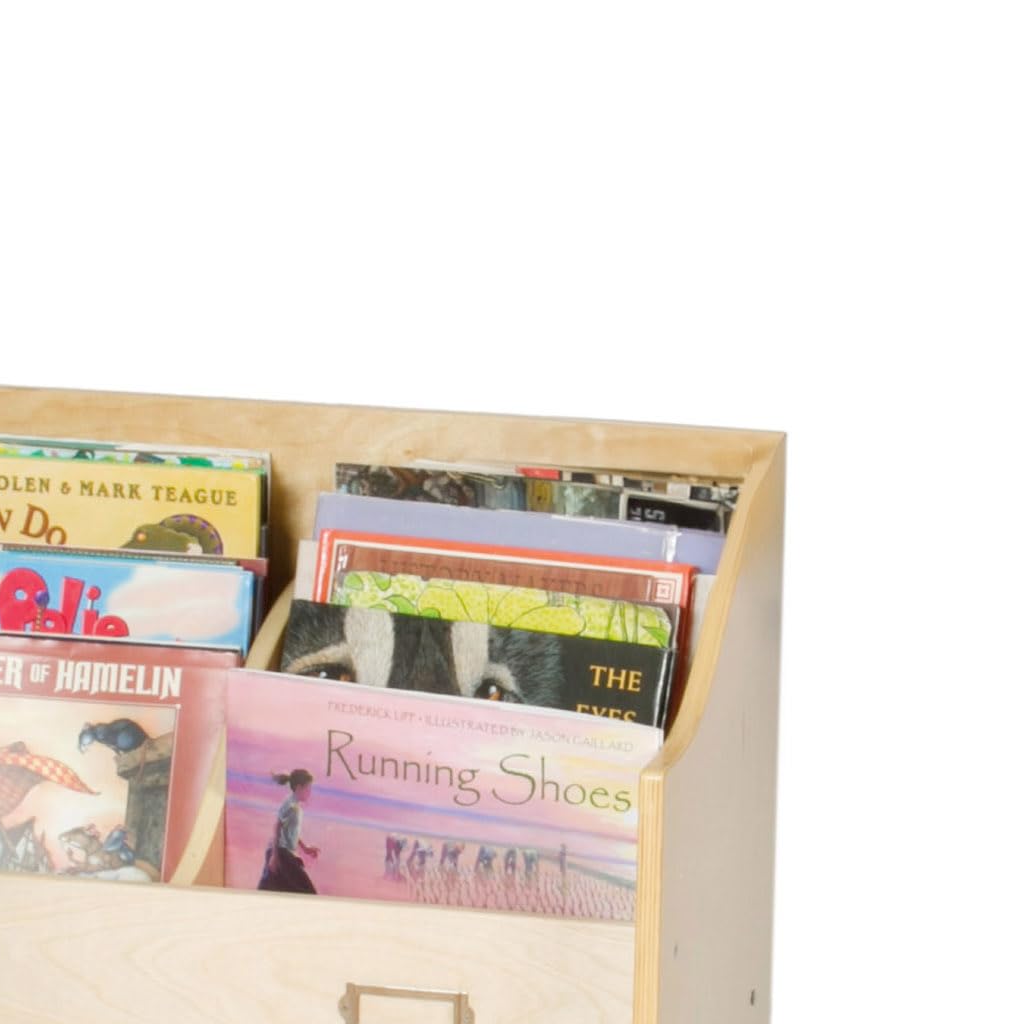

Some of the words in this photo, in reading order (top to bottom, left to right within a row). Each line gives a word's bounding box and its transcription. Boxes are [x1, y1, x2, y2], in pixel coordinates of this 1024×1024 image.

[60, 481, 72, 495] &
[79, 480, 142, 500] MARK
[152, 485, 238, 506] TEAGUE
[30, 664, 50, 683] OF
[55, 659, 182, 700] HAMELIN
[590, 665, 642, 692] THE
[326, 729, 481, 806] Running
[492, 754, 632, 812] Shoes
